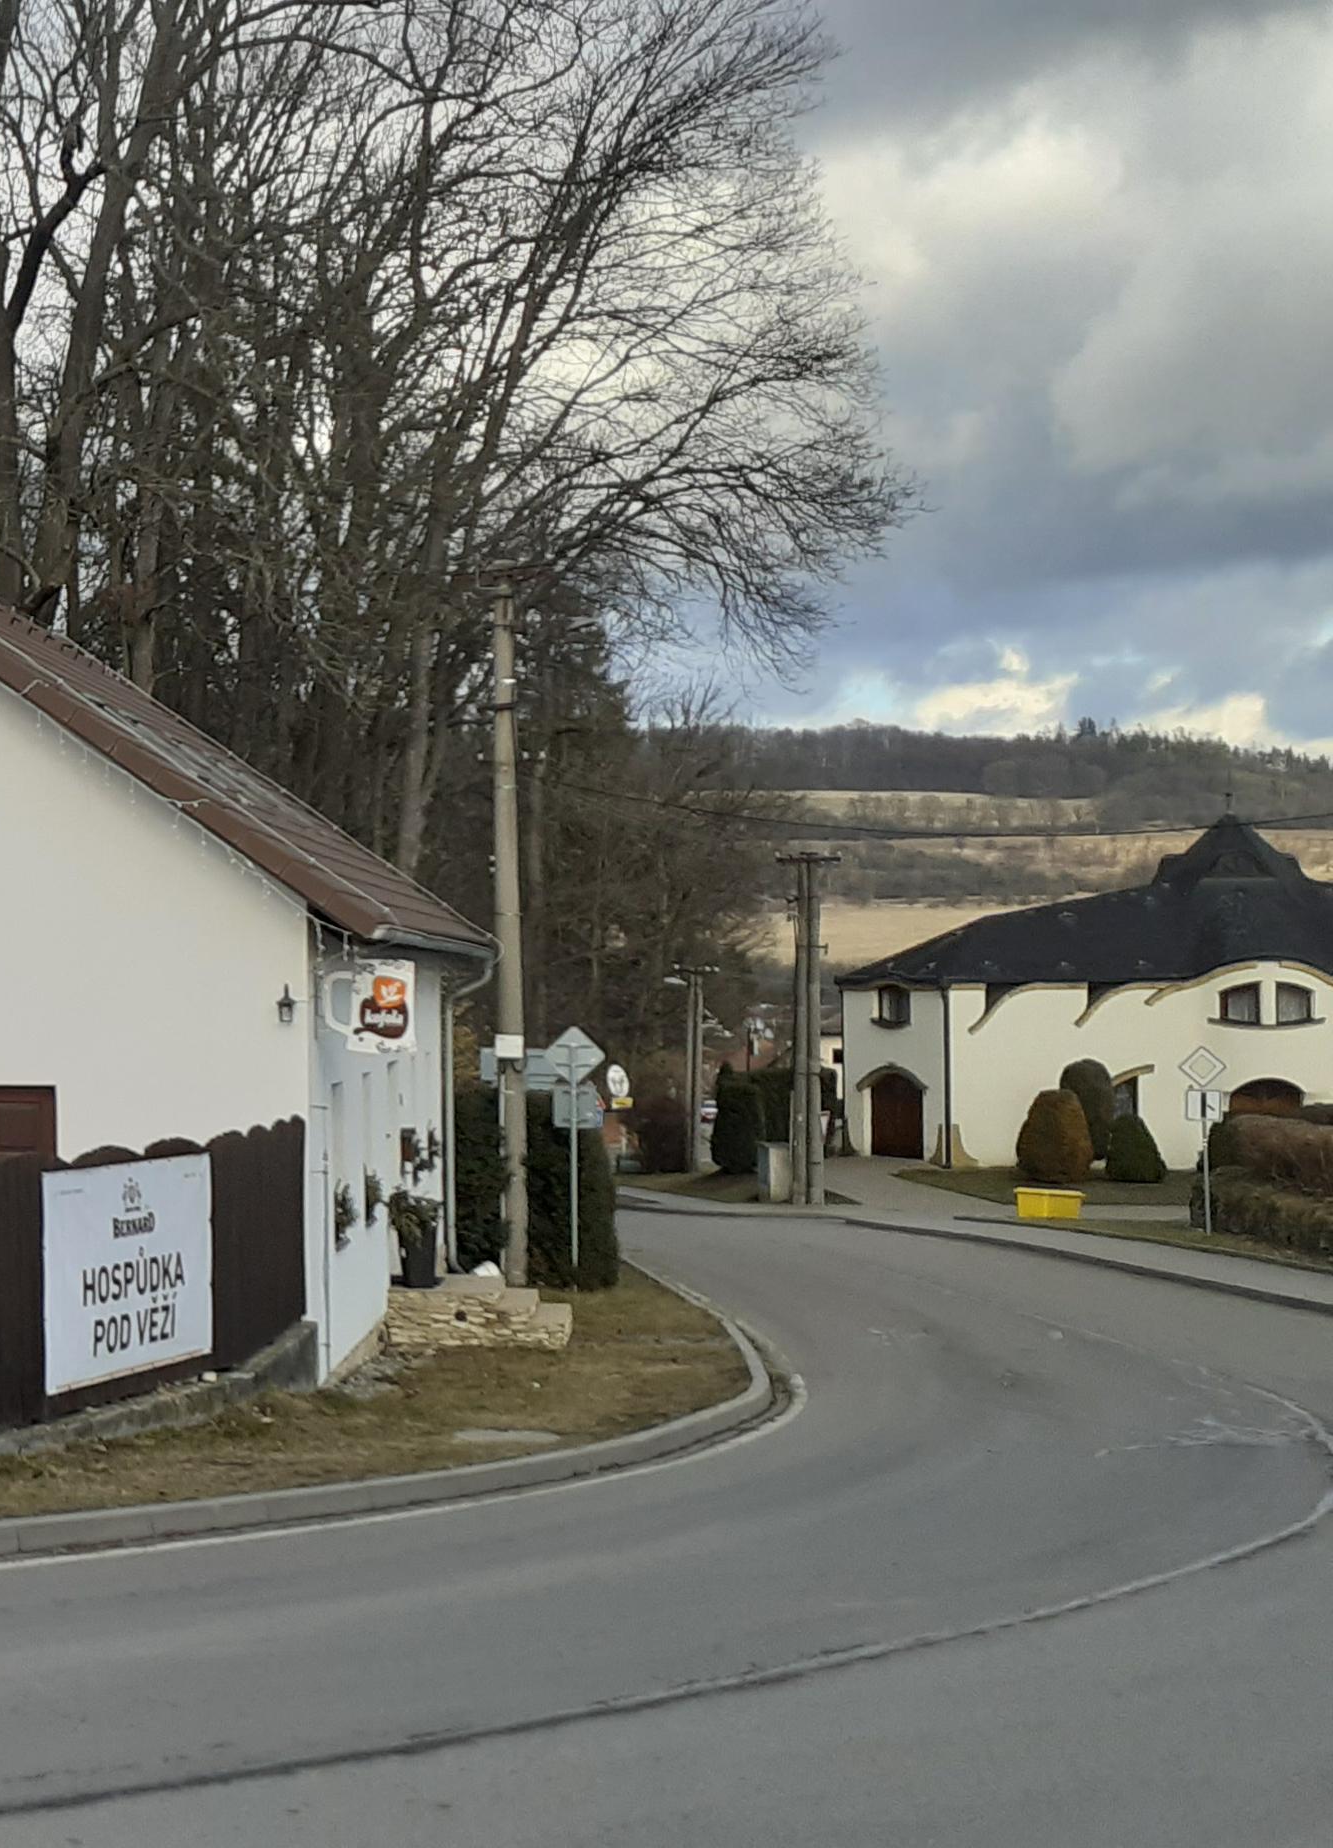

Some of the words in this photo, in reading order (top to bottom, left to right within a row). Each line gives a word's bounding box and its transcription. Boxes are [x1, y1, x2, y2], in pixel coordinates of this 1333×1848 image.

[113, 1212, 155, 1238] BERNARD
[83, 1246, 186, 1307] HOSPŮDKA
[93, 1313, 132, 1358] POD
[137, 1291, 178, 1346] VĚŽÍ
